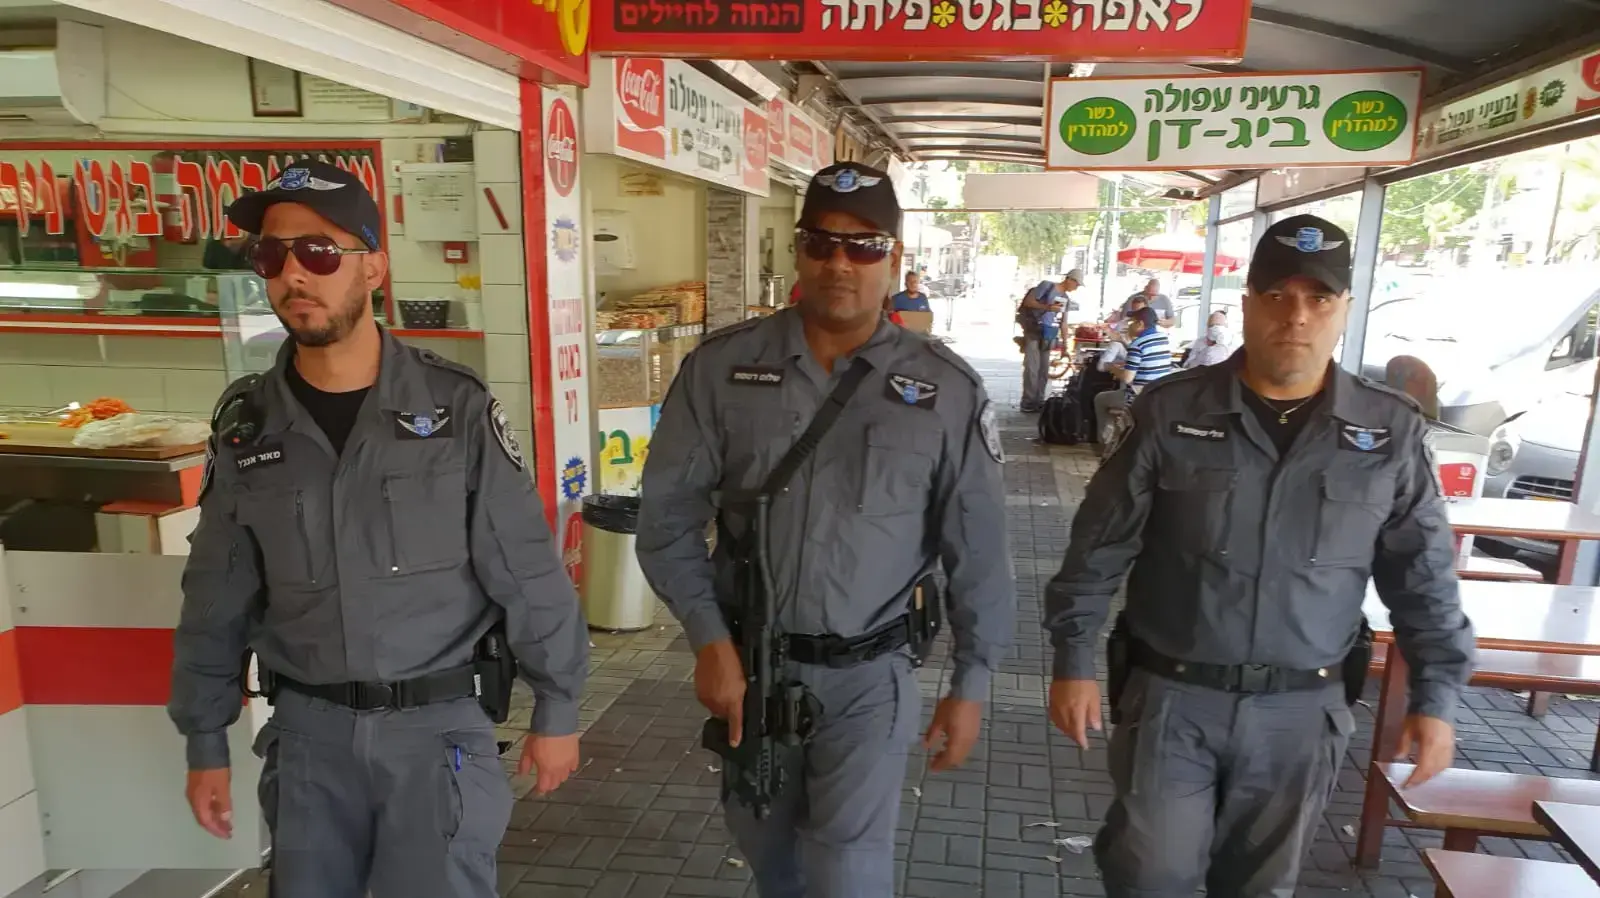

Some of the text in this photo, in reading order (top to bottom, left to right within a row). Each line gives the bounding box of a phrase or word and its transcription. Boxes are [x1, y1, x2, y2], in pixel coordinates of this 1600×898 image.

[620, 0, 800, 26] הנחה לחיילים
[821, 0, 1204, 31] לאפה בגט פיתה
[669, 73, 707, 123] עפולה
[1144, 82, 1321, 113] גרעיני עפולה
[1351, 100, 1385, 114] כשר
[1084, 106, 1115, 119] כשר
[1330, 115, 1399, 138] למהדרין
[1067, 120, 1129, 142] למהדרין
[1147, 116, 1311, 162] ביג-דן
[74, 155, 163, 237] בגט
